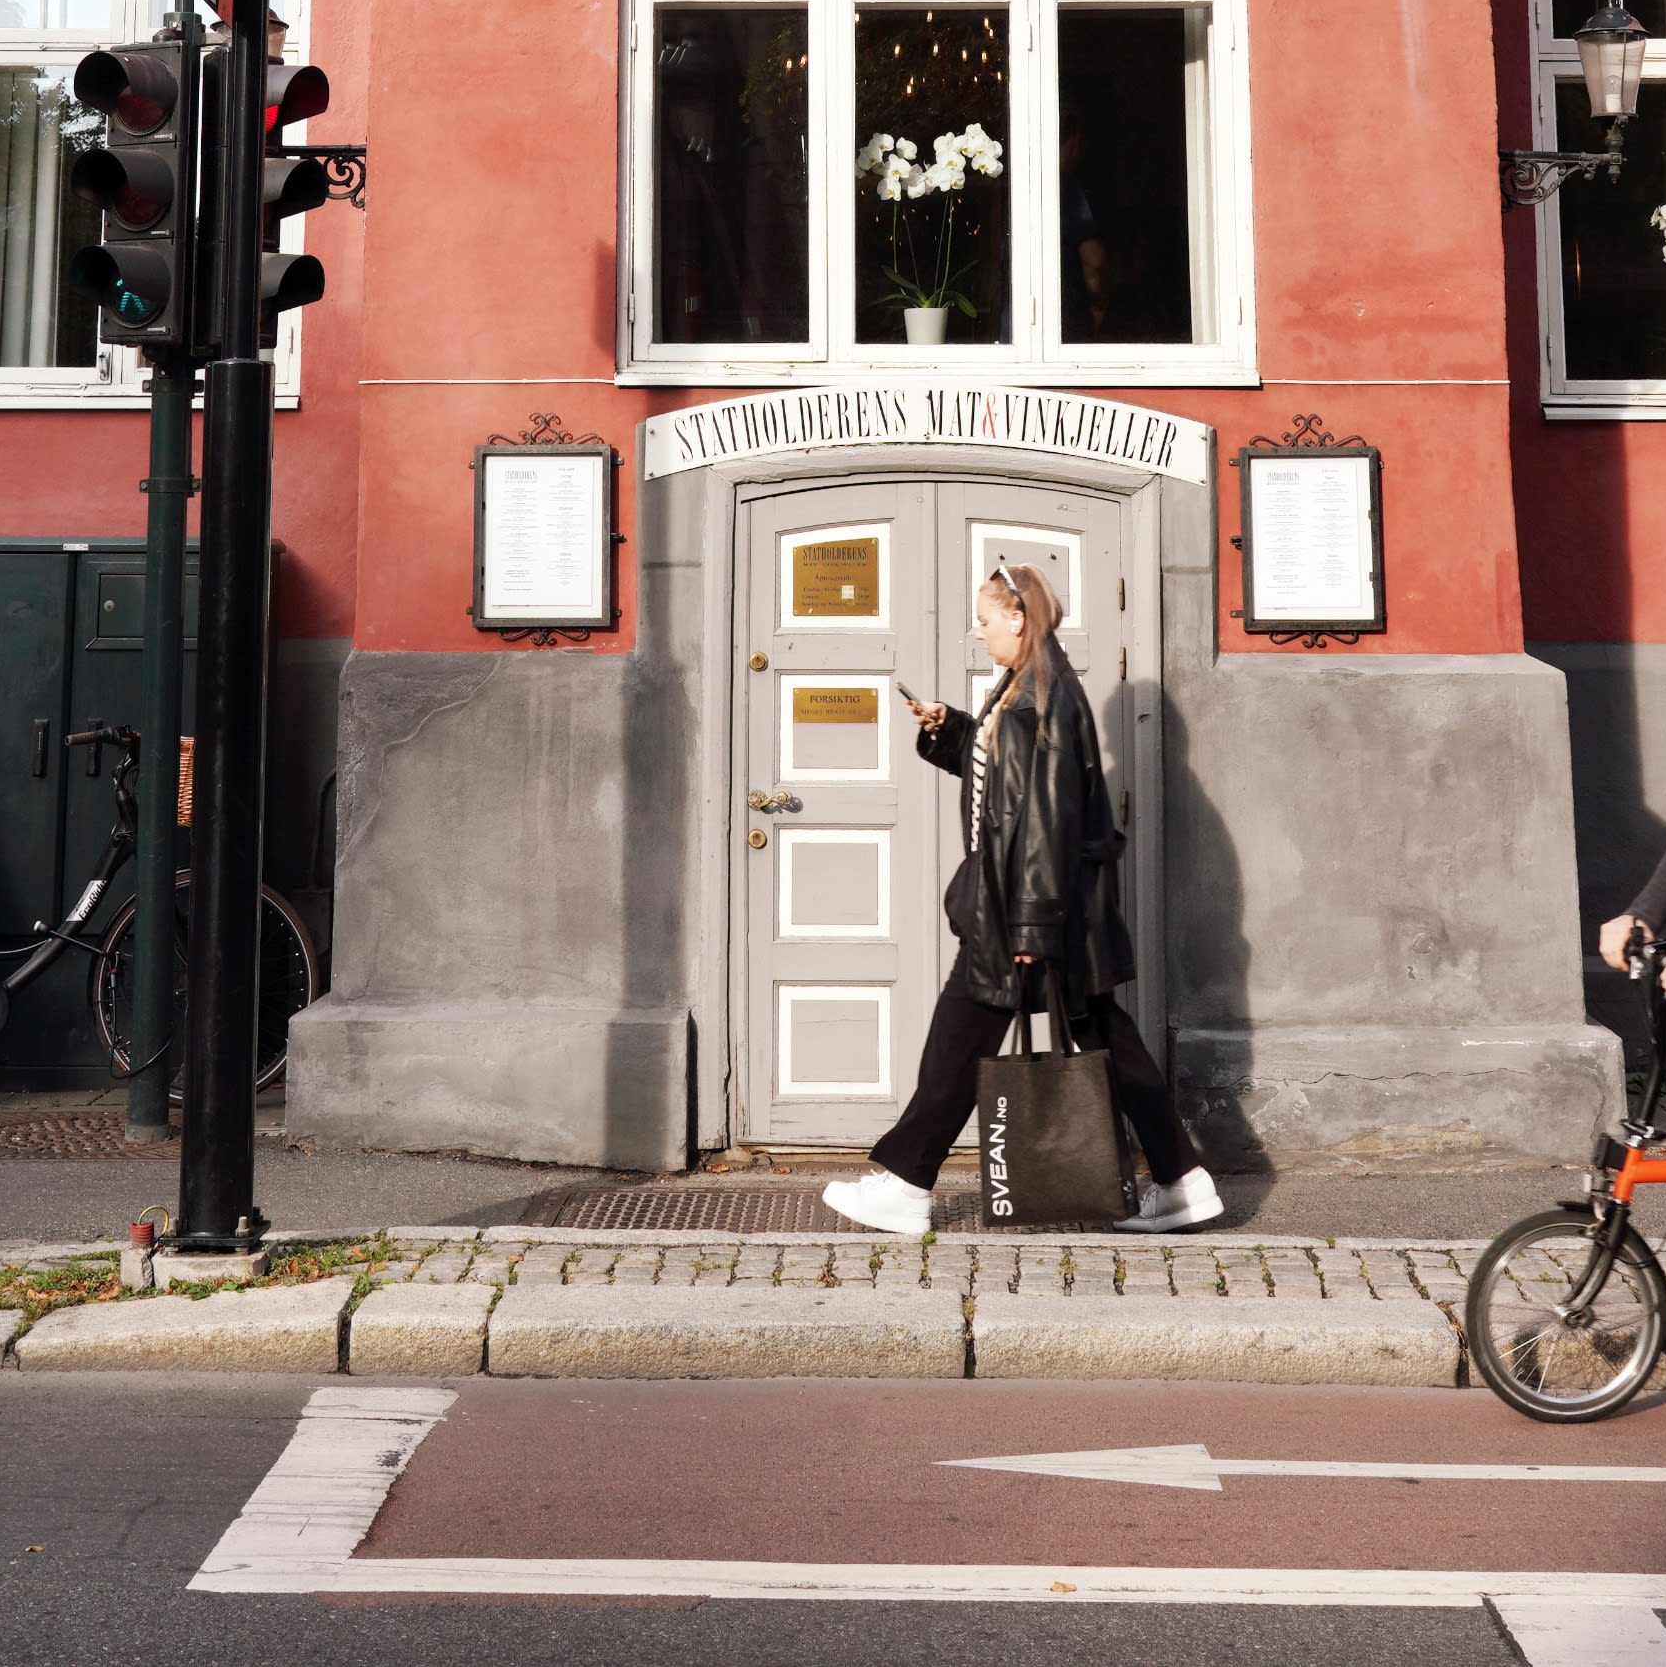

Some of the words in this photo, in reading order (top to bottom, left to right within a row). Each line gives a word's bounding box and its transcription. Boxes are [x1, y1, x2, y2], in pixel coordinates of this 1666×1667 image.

[674, 388, 908, 463] STATHOLDERENS
[803, 546, 867, 561] STATHOLDERENS
[809, 695, 861, 704] FORSIKTIG
